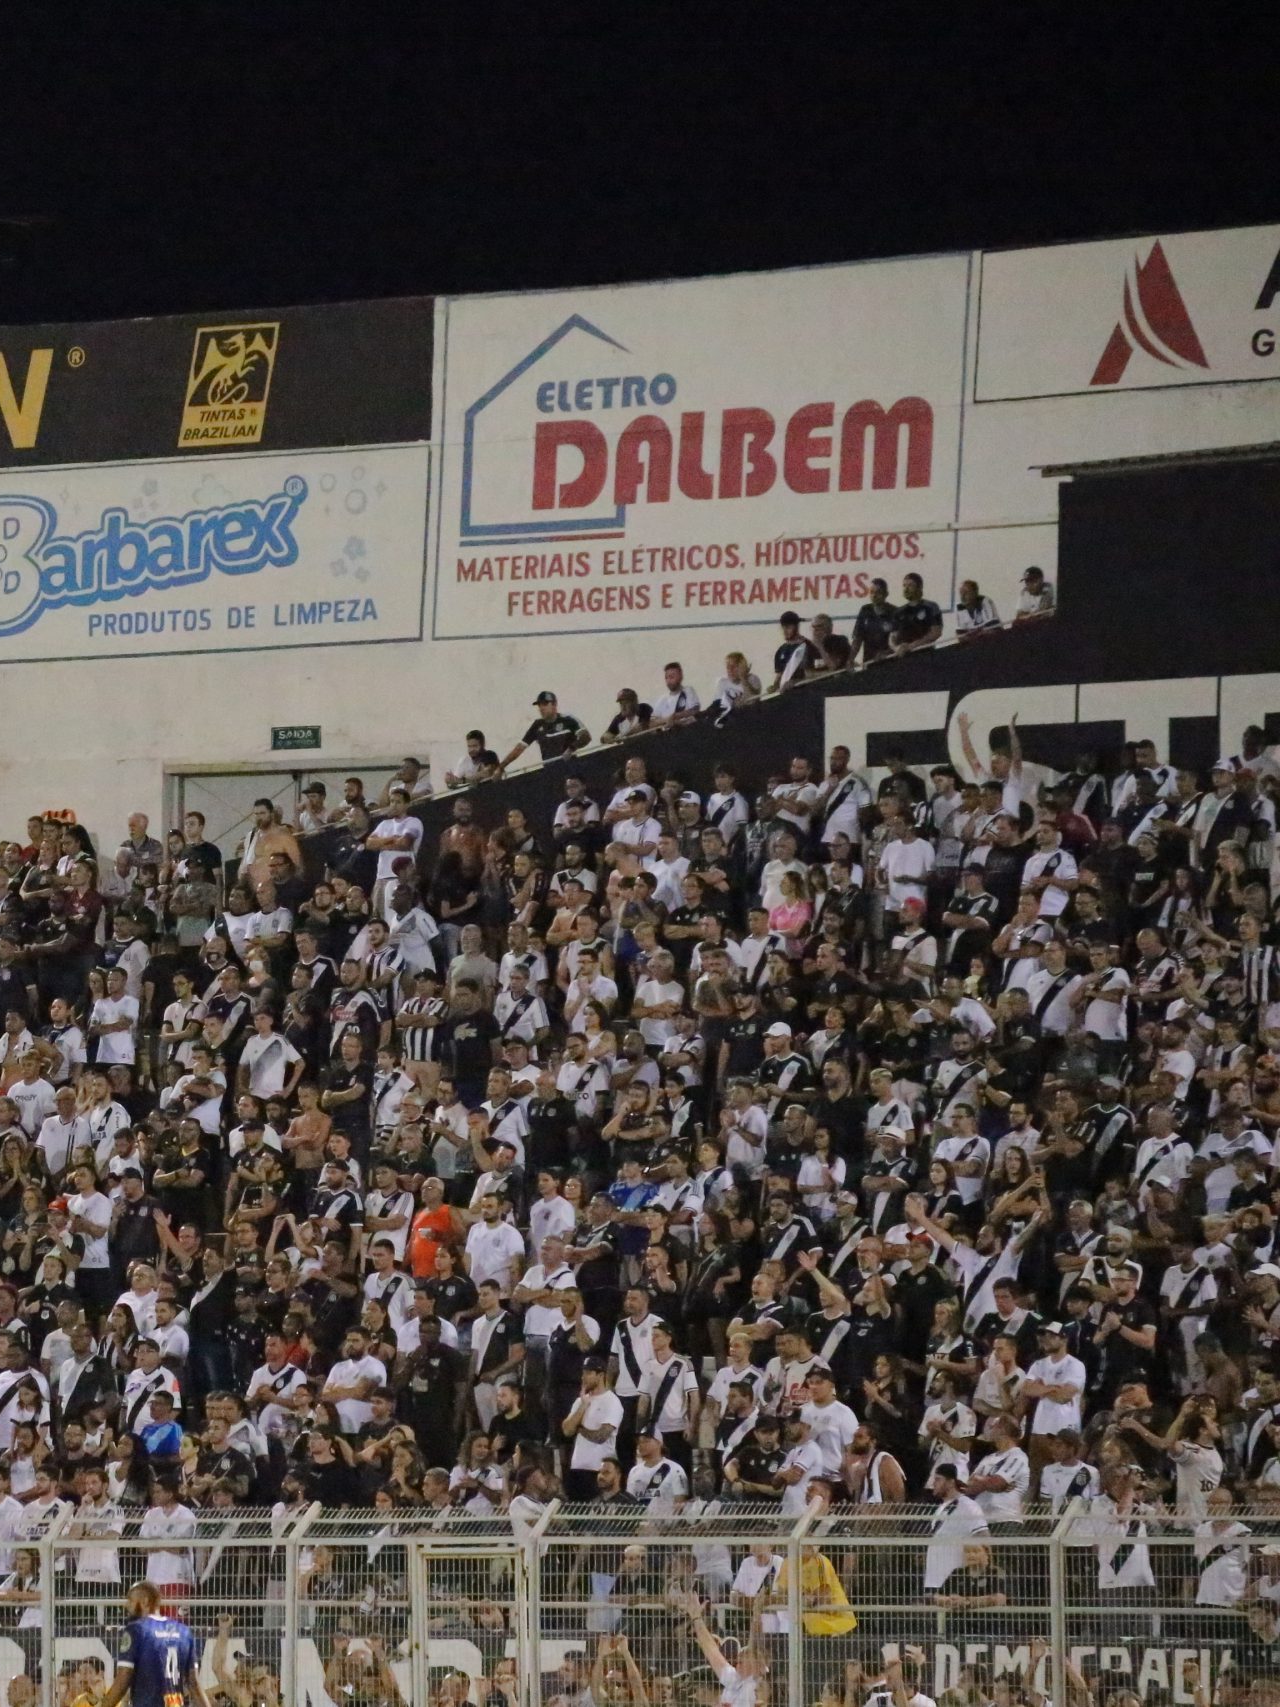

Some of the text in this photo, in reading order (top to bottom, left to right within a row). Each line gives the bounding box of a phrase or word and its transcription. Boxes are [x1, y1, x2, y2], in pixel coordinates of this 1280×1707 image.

[536, 373, 677, 413] ELETRO
[182, 423, 258, 441] BRAZILIAN
[199, 407, 246, 423] TINTAS
[532, 396, 935, 511] DALBEM
[456, 552, 592, 583] MATERIAIS
[88, 598, 379, 637] PRODUTOS DE LIMPEZA
[506, 584, 651, 617] FERRAGENS
[661, 583, 674, 609] E
[825, 672, 1280, 800] EST
